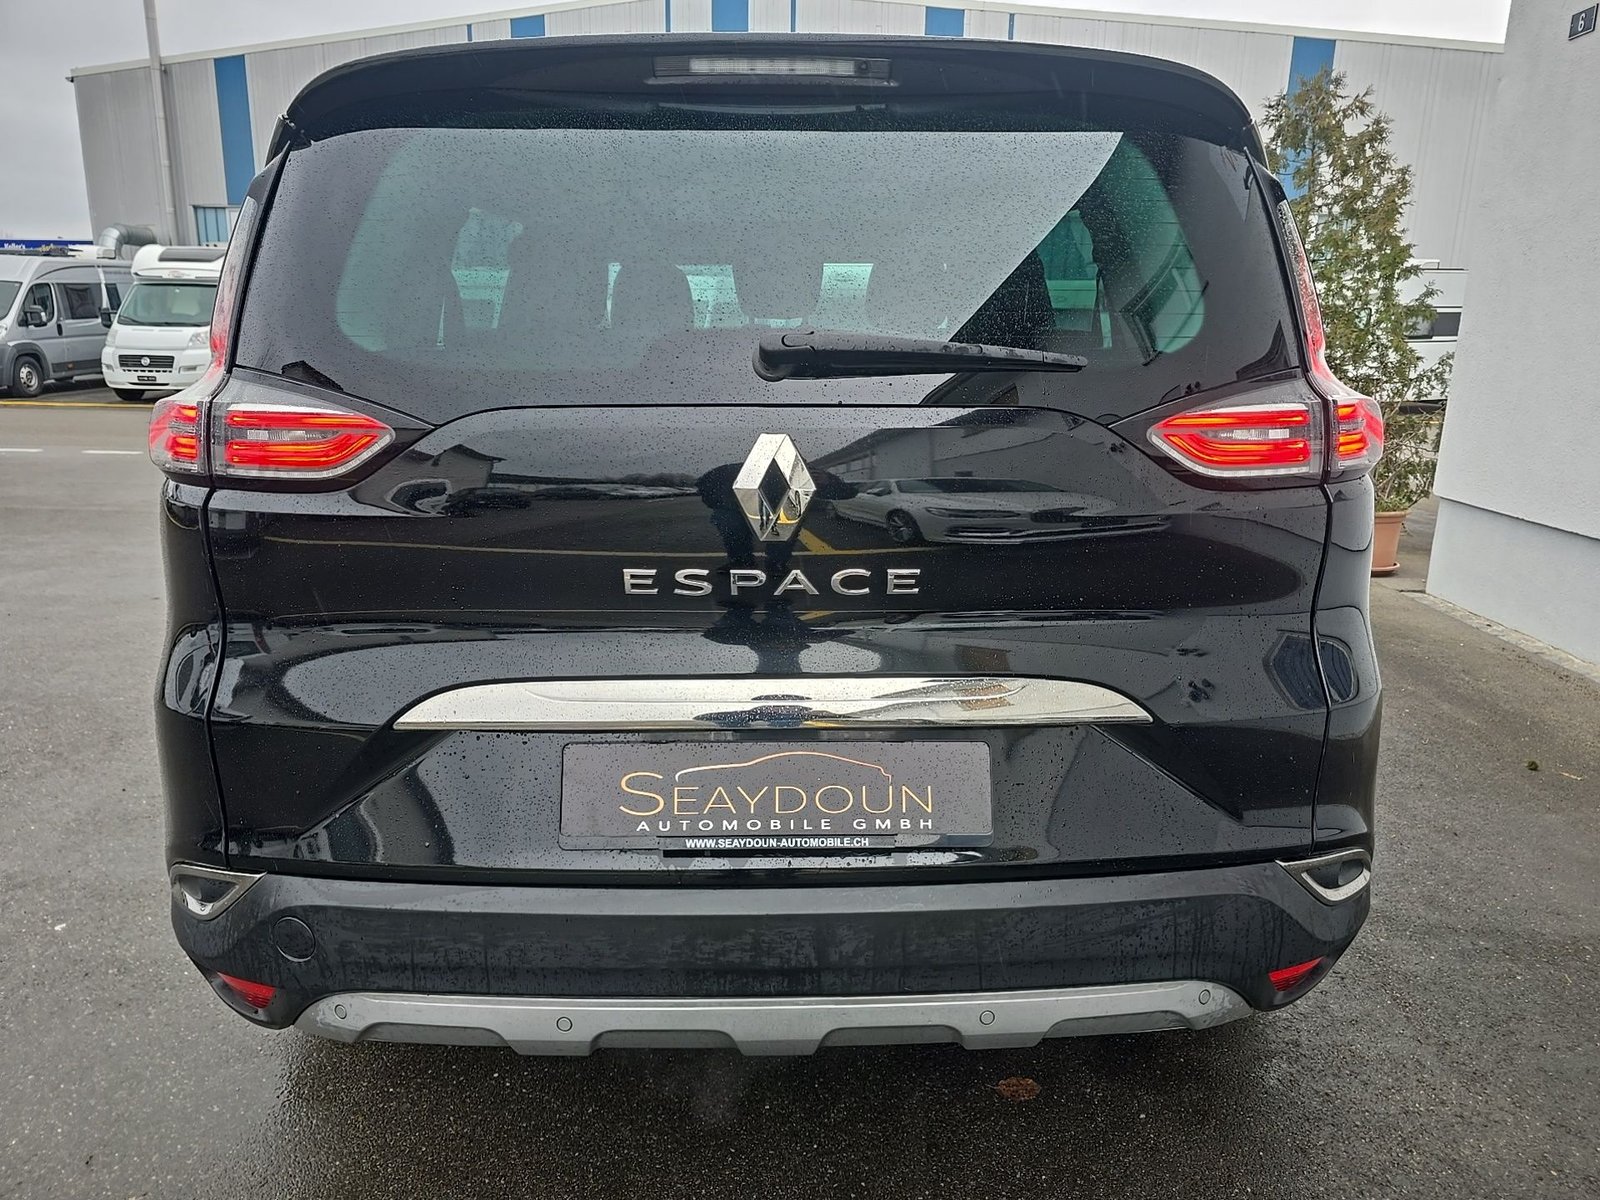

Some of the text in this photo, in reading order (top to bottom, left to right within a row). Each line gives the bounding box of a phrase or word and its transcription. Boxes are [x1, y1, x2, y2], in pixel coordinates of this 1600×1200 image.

[1578, 12, 1586, 31] 6
[622, 568, 921, 596] ESPACE
[635, 817, 934, 832] AUTOMOBILE GMBH
[685, 837, 870, 849] WWW.SEAYDOUN-AUTOMOBILE.CH
